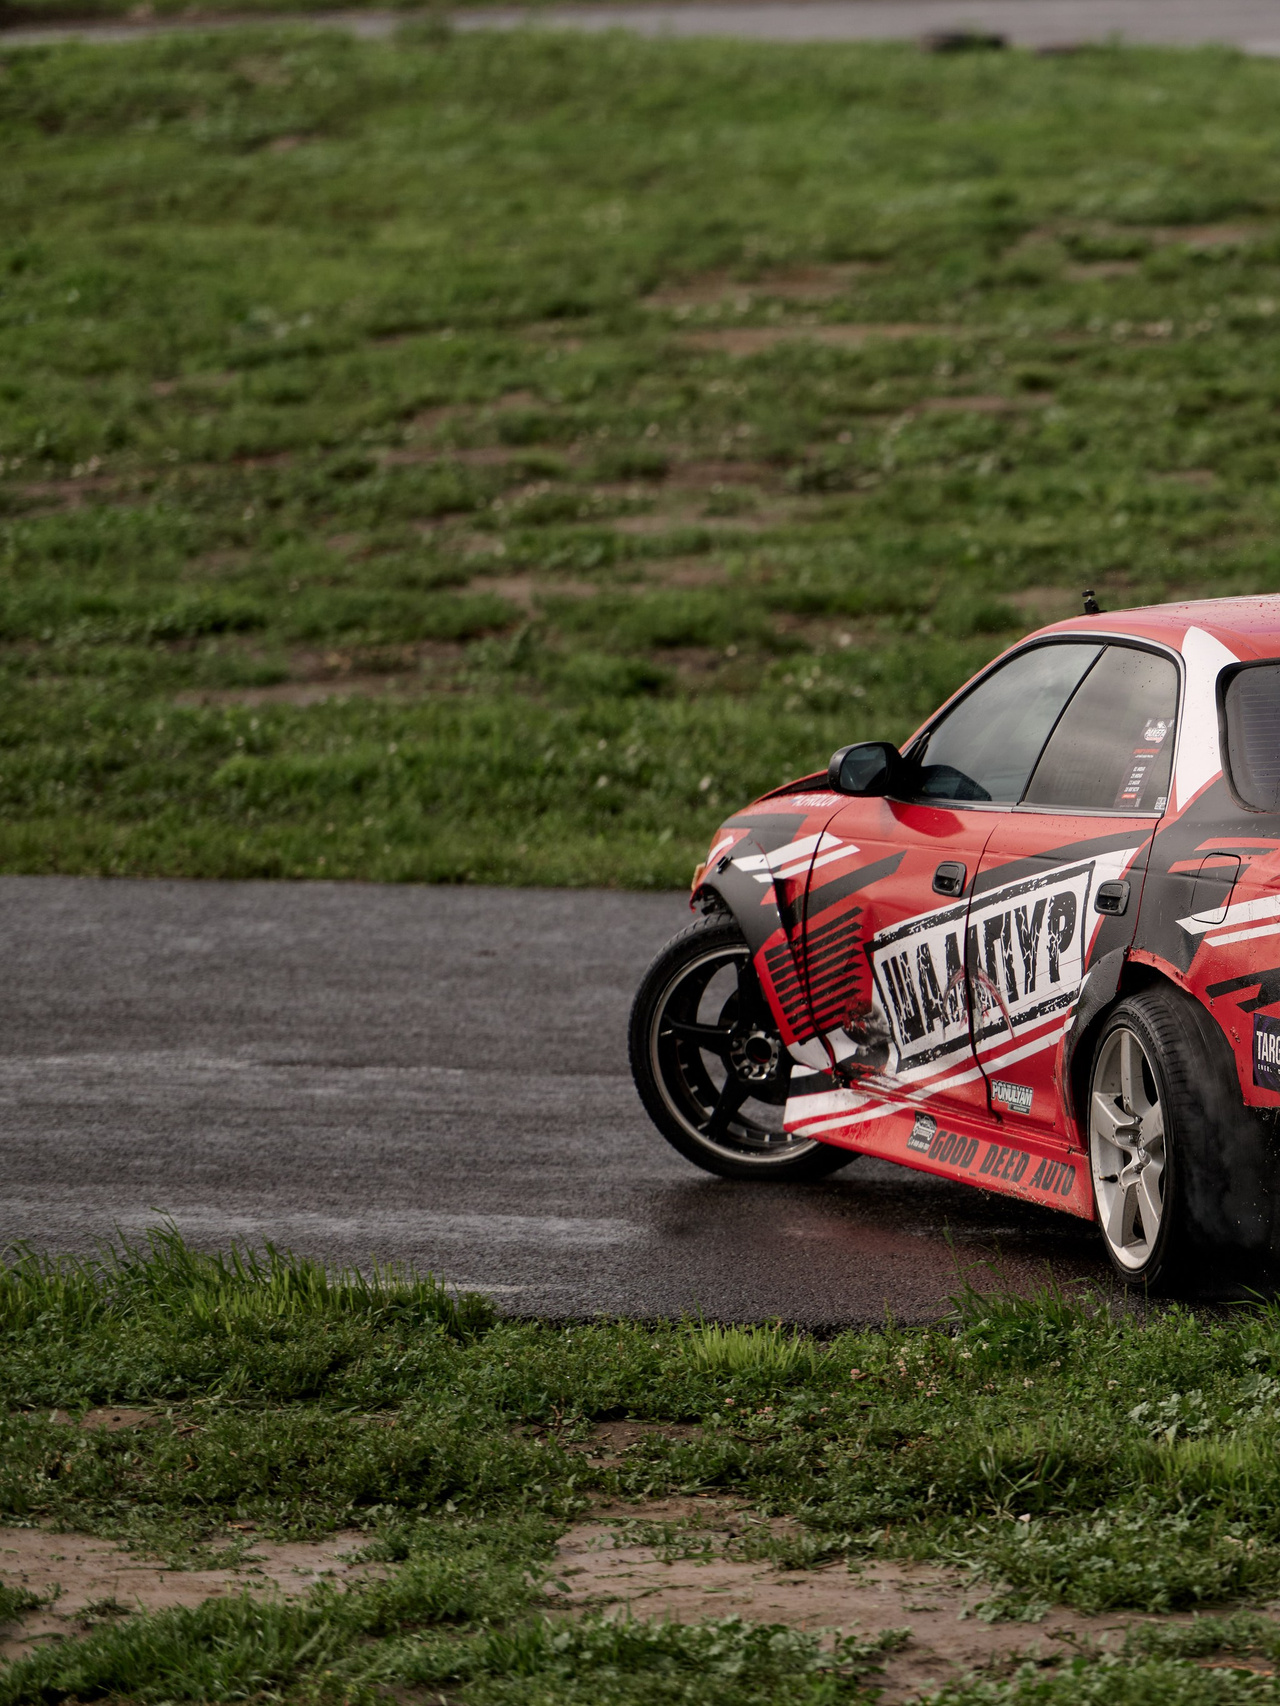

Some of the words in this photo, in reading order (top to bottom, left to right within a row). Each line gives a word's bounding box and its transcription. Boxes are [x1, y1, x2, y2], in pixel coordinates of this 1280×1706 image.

[928, 1130, 980, 1169] GOOD
[979, 1143, 1031, 1184] DEED
[1028, 1157, 1077, 1197] AUTO
